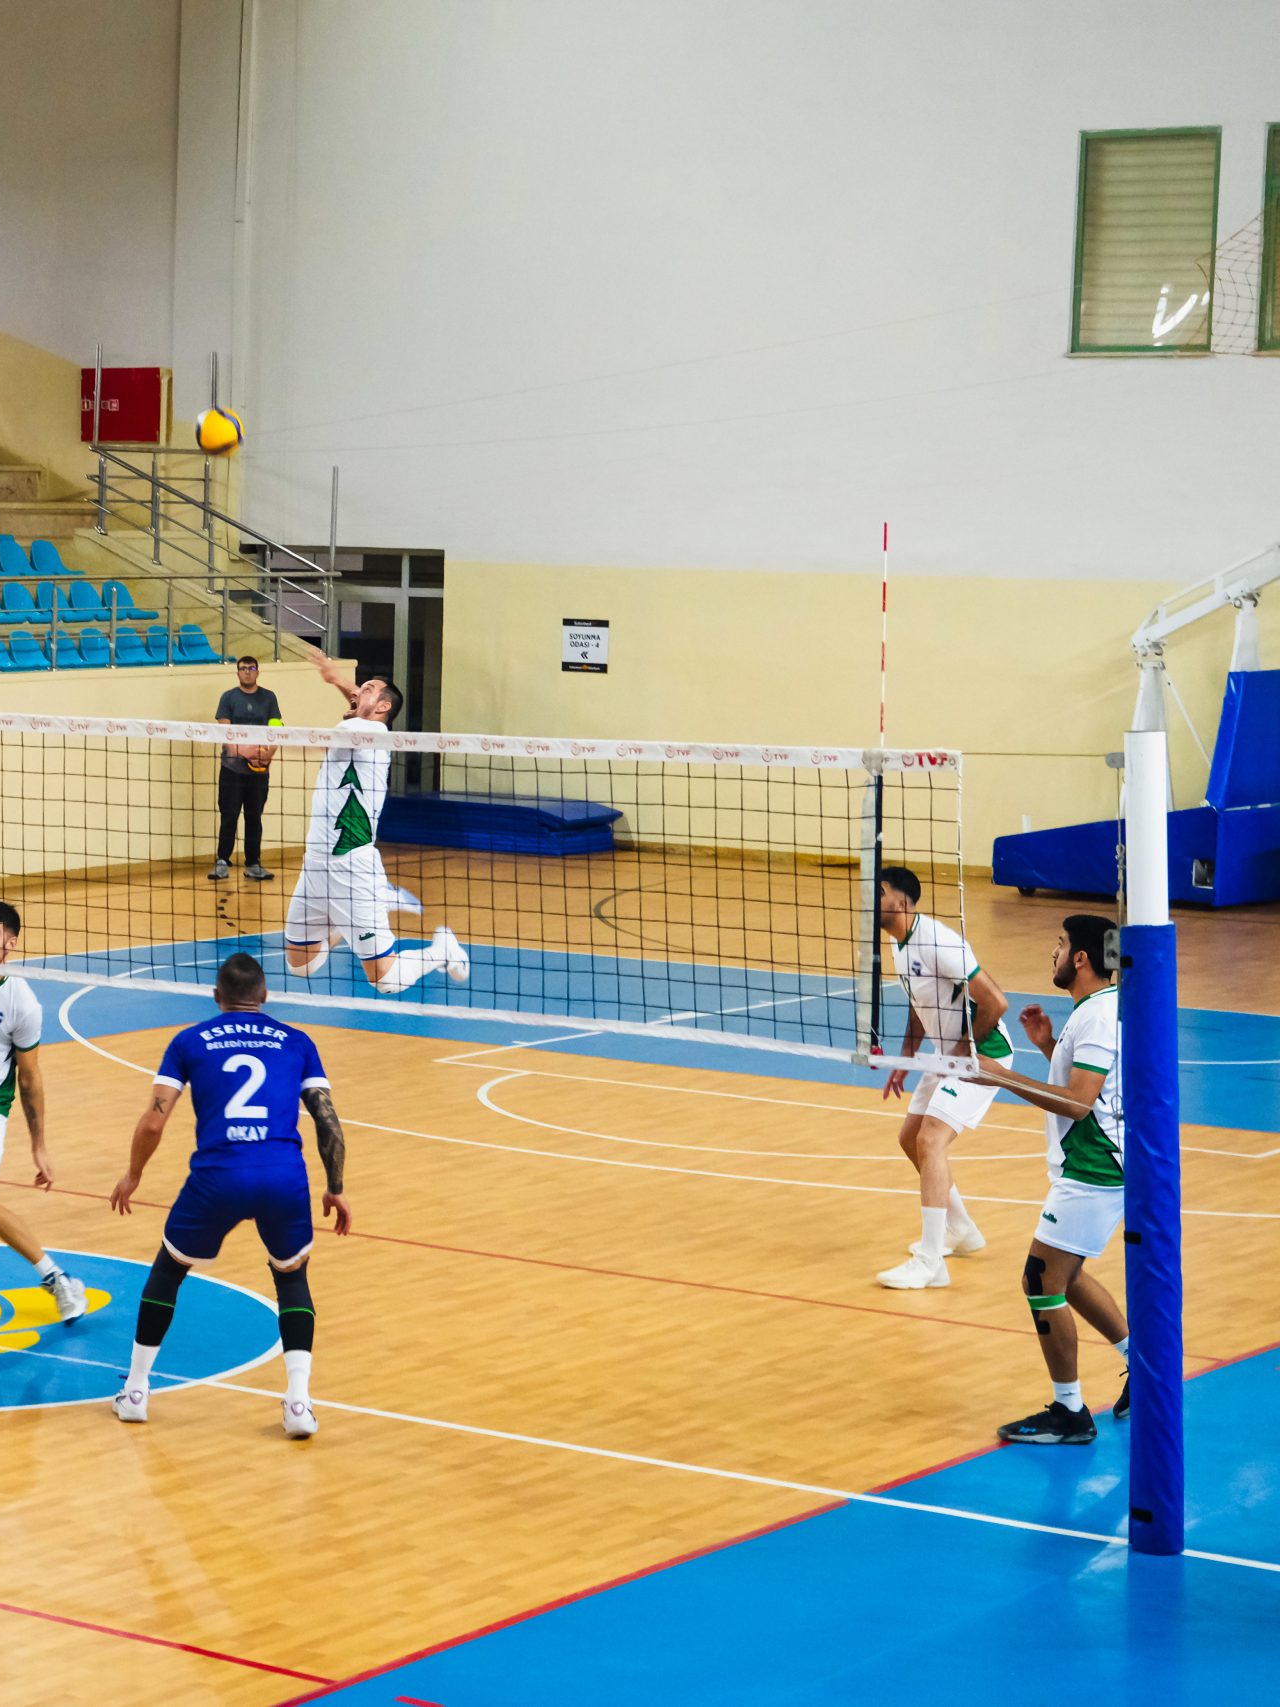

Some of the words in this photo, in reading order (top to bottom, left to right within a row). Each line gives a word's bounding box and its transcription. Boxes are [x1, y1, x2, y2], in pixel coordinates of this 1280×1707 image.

[569, 633, 601, 641] SOYUNMA
[582, 747, 596, 755] TVF
[628, 748, 643, 756] TVF
[675, 749, 691, 758] TVF
[725, 752, 740, 760] TVF
[774, 754, 789, 762] TVF
[823, 755, 838, 763] TVF
[199, 1023, 289, 1042] ESENLER
[221, 1053, 269, 1119] 2
[226, 1125, 269, 1142] OKAY
